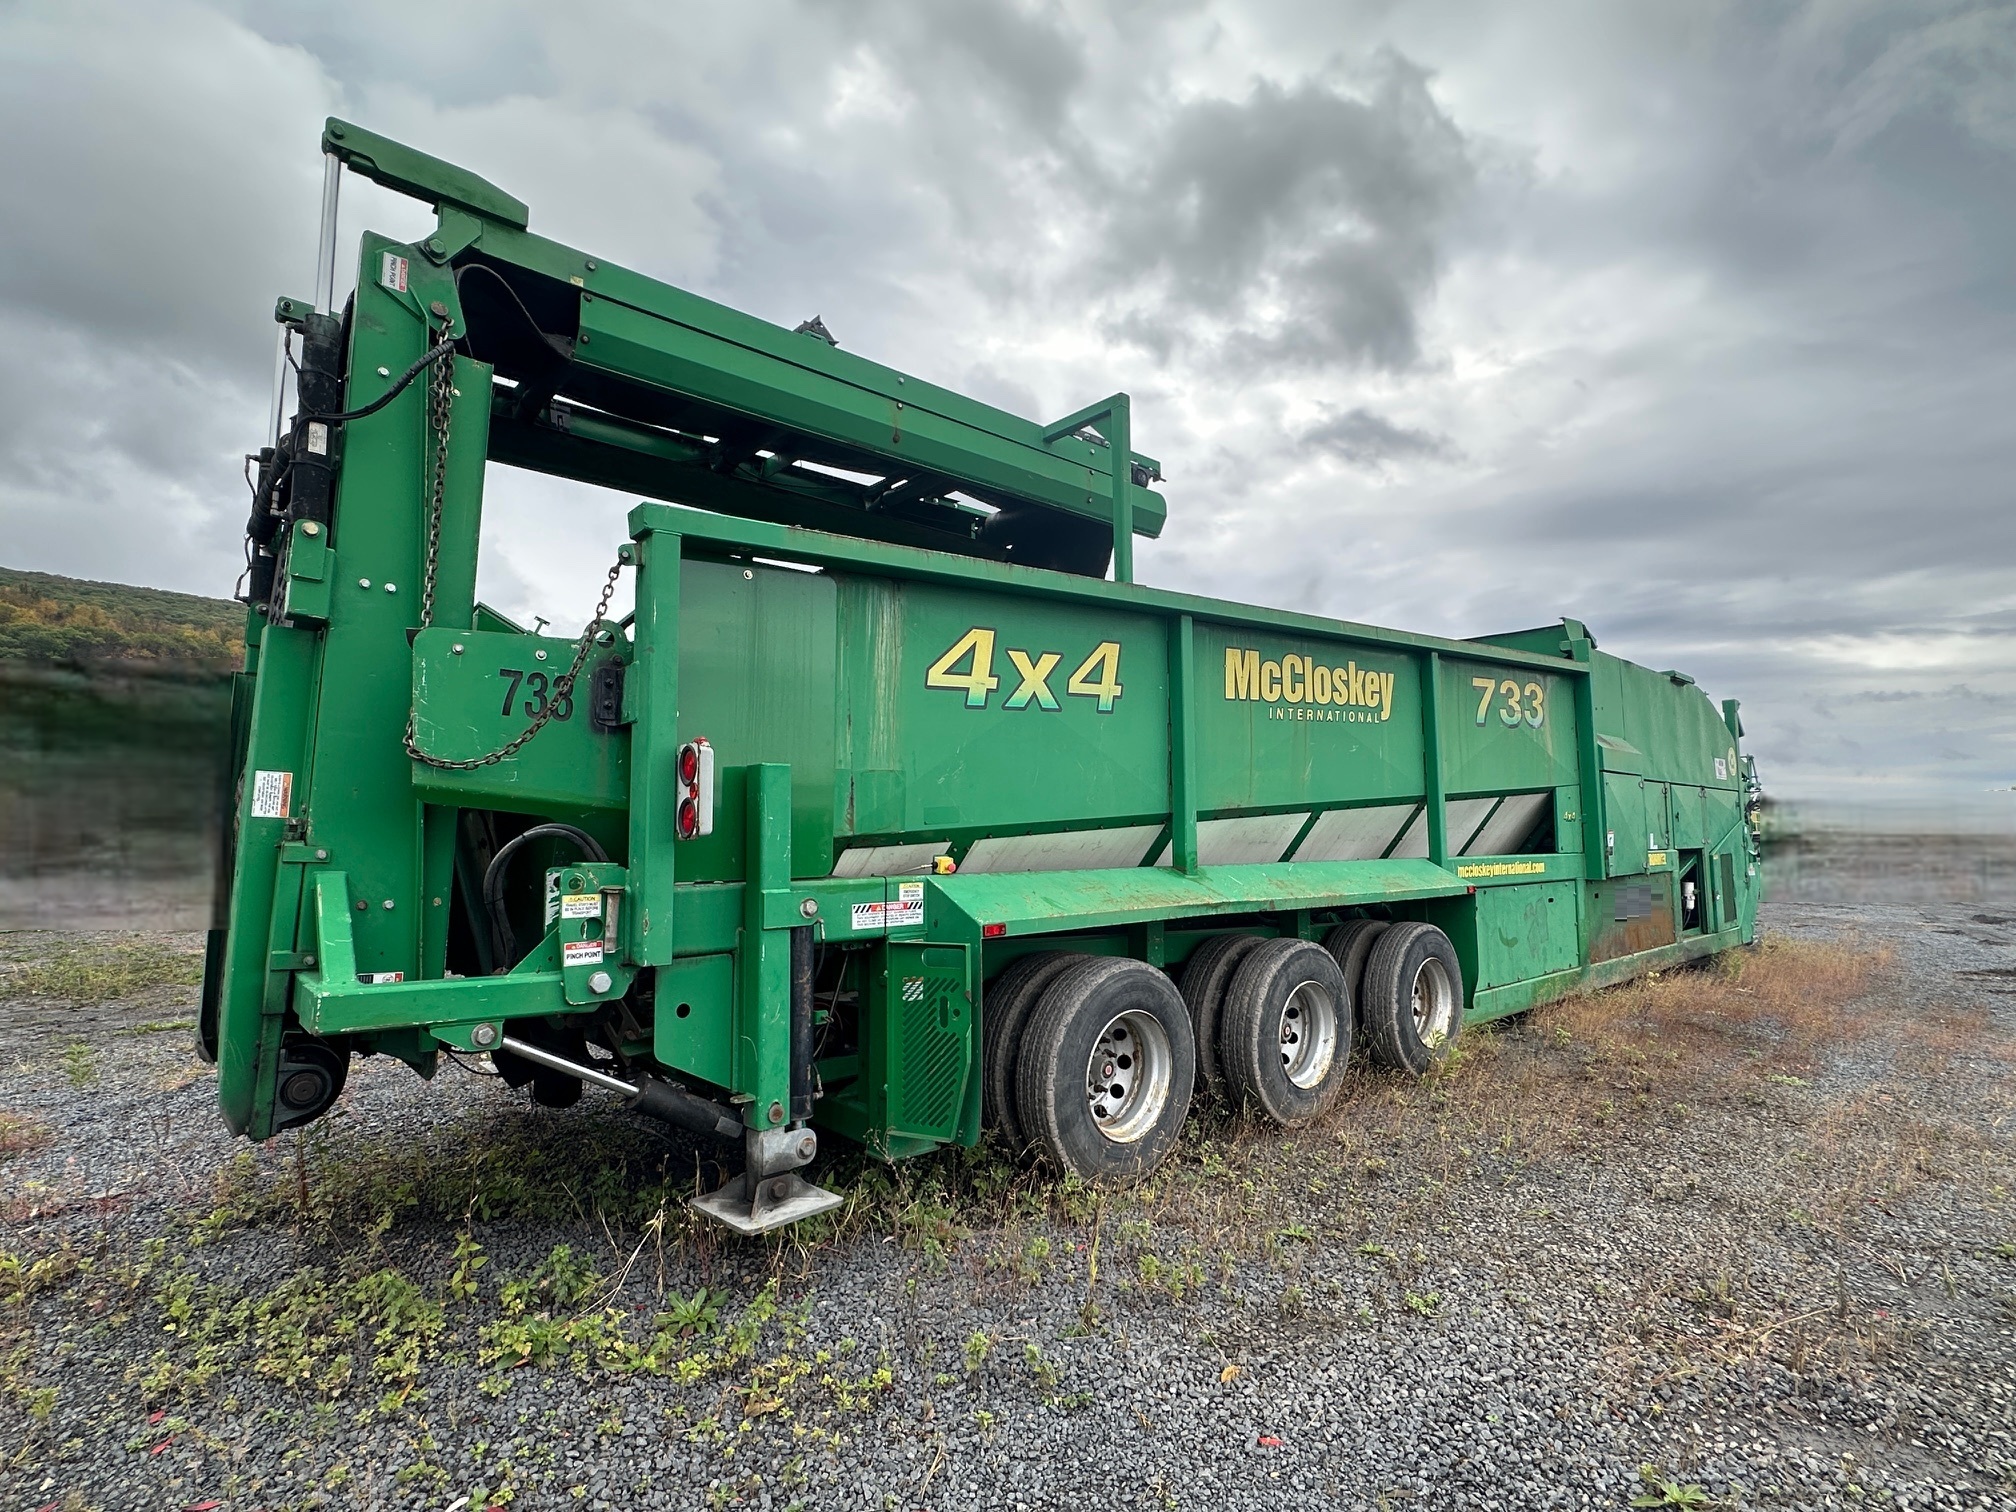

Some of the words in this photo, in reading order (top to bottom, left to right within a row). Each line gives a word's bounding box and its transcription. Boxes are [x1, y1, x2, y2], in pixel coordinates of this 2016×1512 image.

[925, 626, 1124, 714] 4x4
[1225, 647, 1395, 721] McCloskey
[1269, 707, 1380, 724] INTERNATIONAL
[1472, 677, 1544, 728] 733
[1457, 861, 1545, 878] mccloskeyinternational.com
